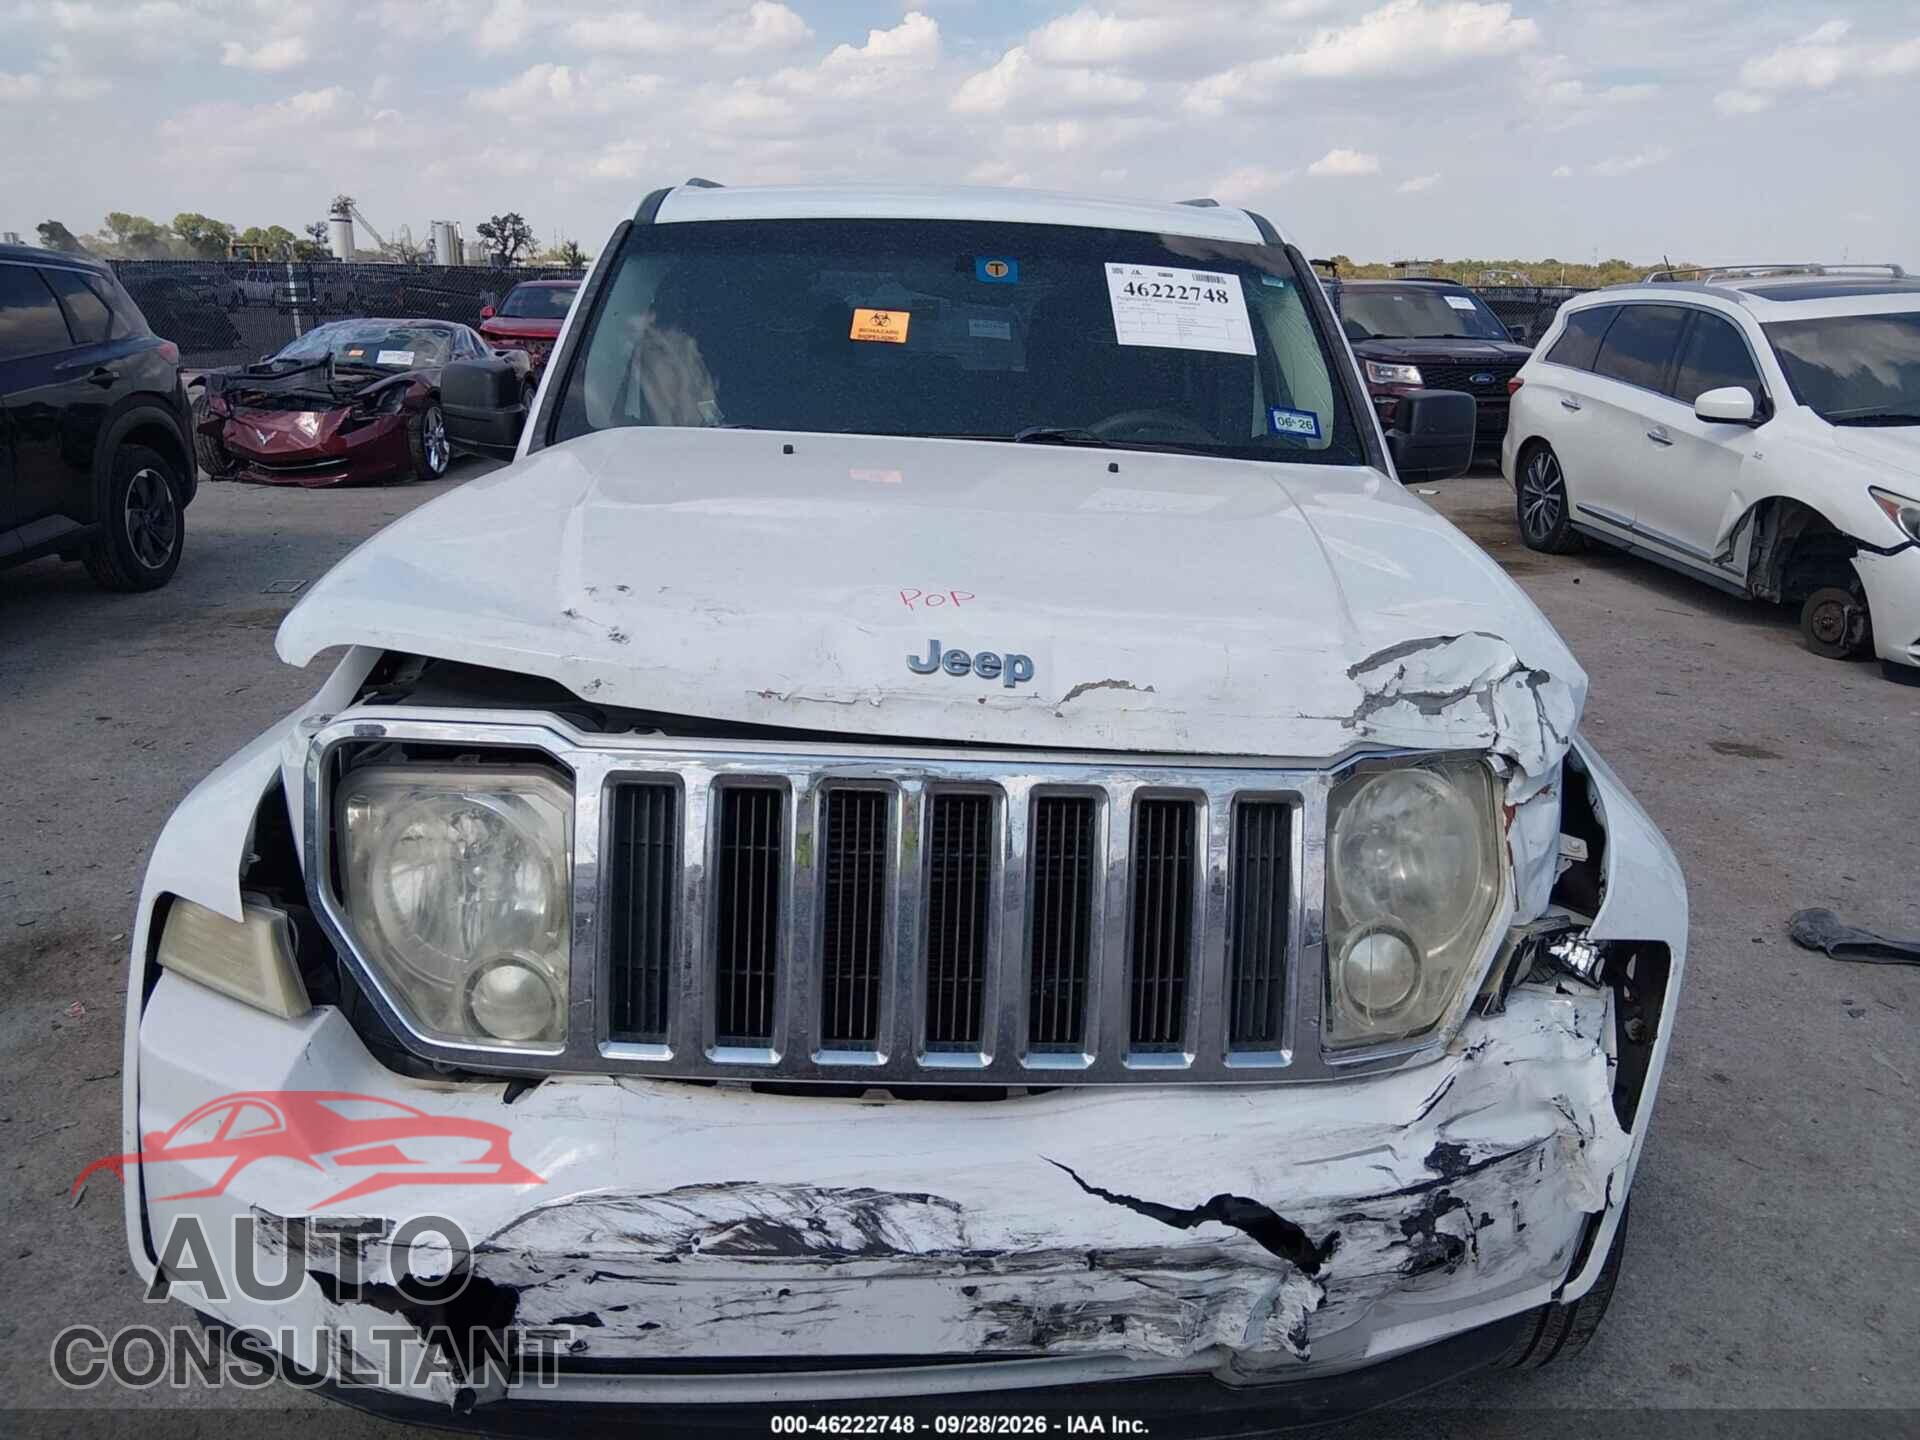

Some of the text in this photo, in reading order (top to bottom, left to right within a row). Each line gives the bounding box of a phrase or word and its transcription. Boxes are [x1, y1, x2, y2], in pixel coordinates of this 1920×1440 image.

[988, 263, 1004, 276] T
[1123, 281, 1229, 304] 46222748
[906, 639, 1034, 688] Jeep
